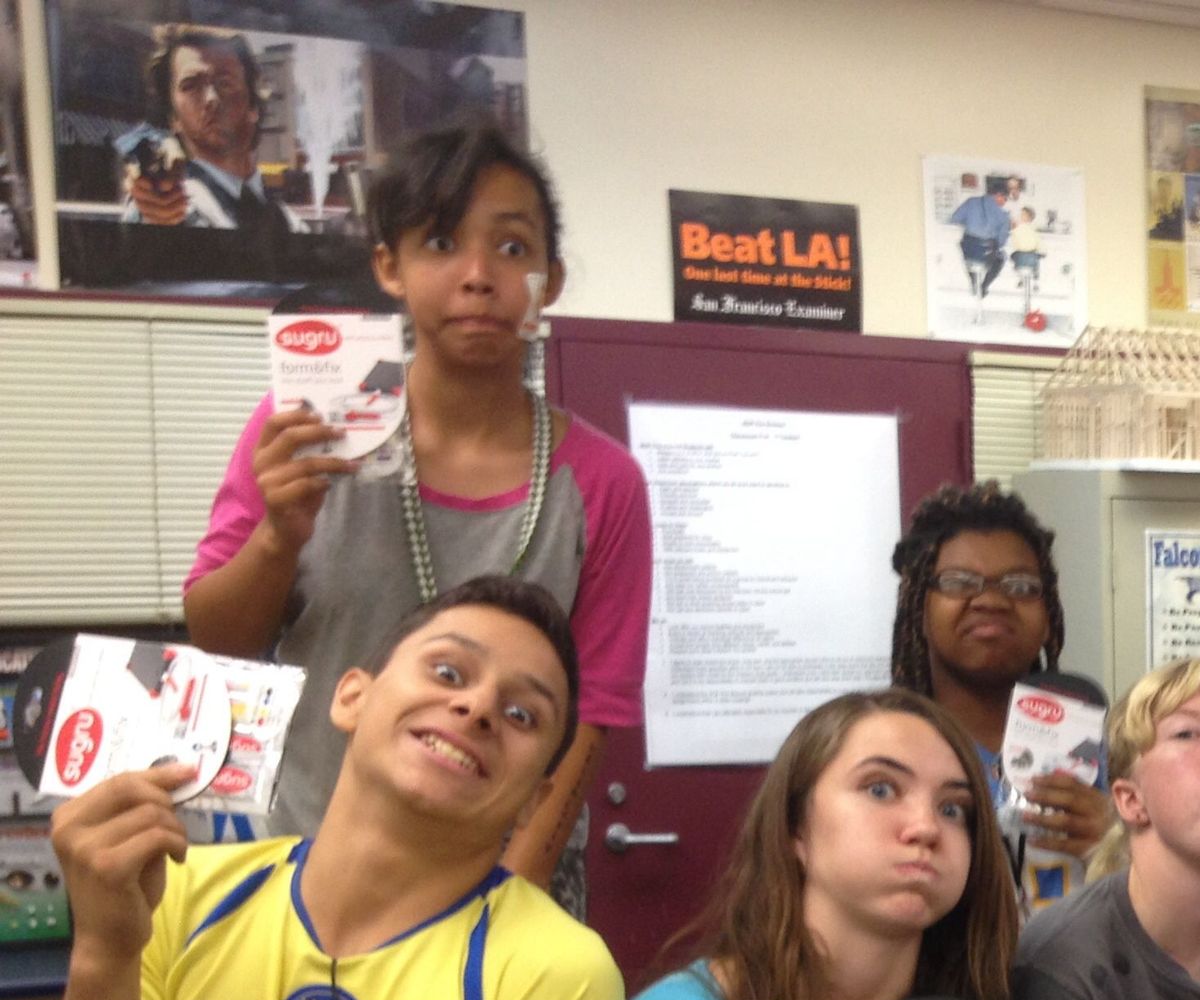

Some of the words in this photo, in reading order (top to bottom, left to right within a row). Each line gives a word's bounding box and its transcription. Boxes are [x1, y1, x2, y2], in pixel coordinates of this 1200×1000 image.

[680, 221, 776, 266] Beat
[782, 229, 851, 271] LA!
[682, 265, 712, 280] One
[691, 292, 719, 312] San
[720, 293, 783, 316] Francisco
[784, 299, 847, 321] Examiner
[281, 330, 338, 351] sugru
[63, 711, 95, 783] sugru
